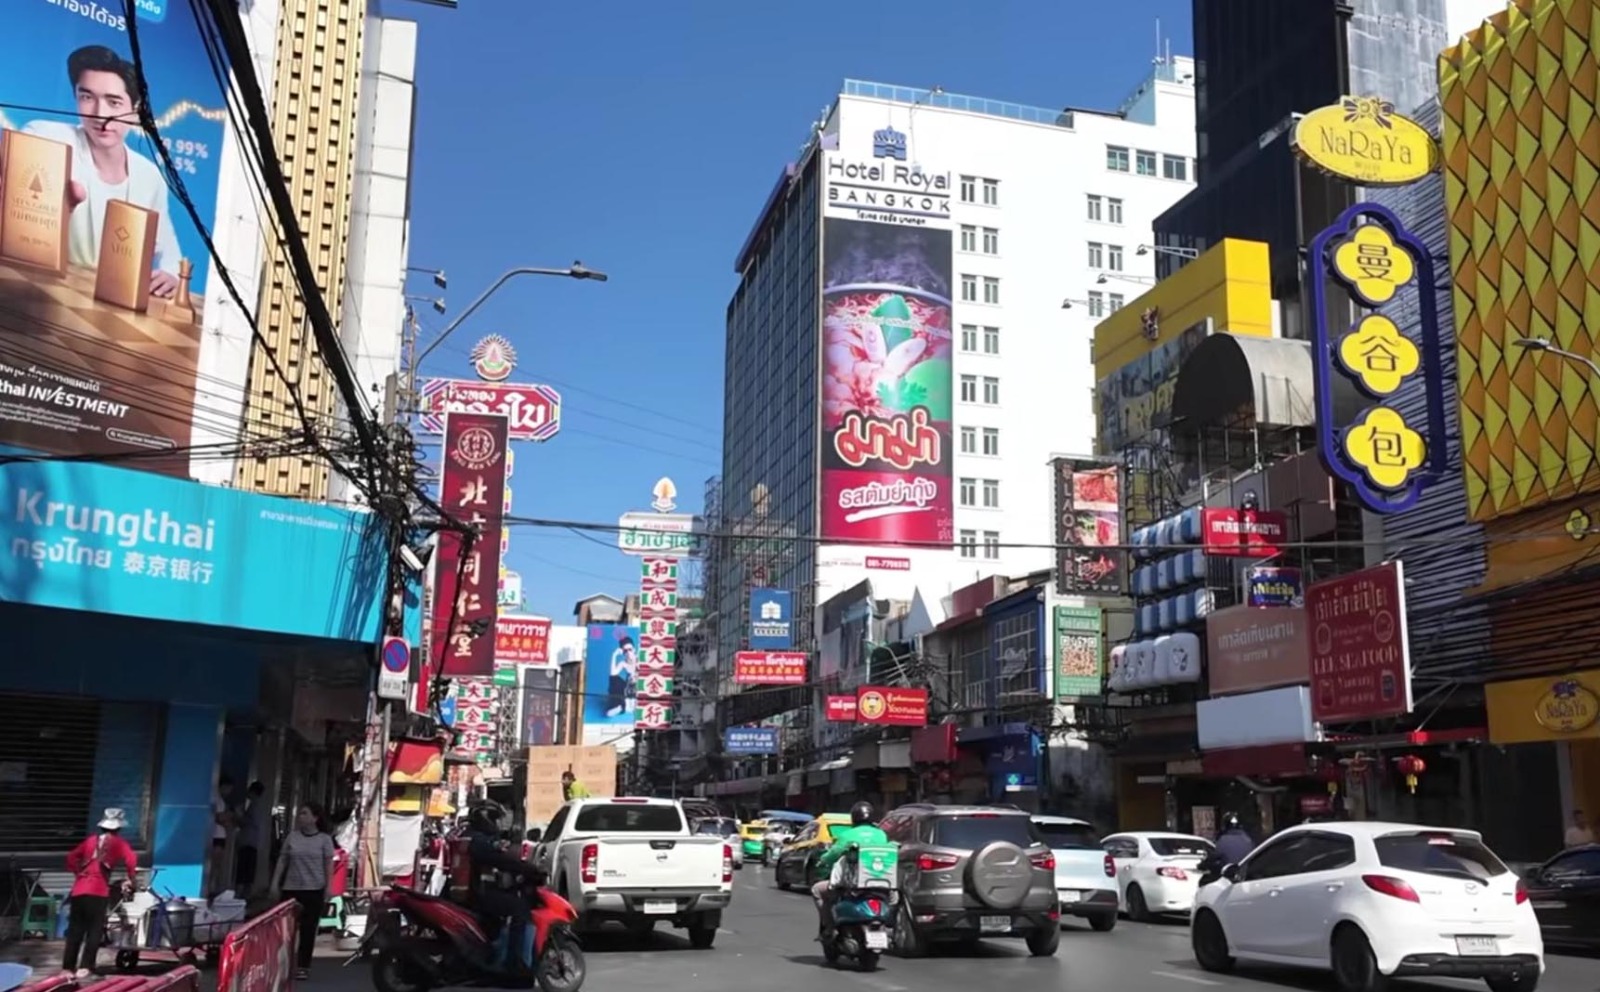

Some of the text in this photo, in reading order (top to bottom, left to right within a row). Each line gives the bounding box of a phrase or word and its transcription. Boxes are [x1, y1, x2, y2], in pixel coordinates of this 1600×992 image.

[1319, 126, 1413, 165] NaRaYa
[828, 187, 951, 212] BANGKOK
[829, 157, 951, 193] Hotel Royal
[1357, 243, 1407, 467] 曼谷包
[835, 408, 941, 470] มาม่า
[16, 487, 216, 551] Krungthai
[12, 536, 214, 585] กรุงไทย 泰京银行
